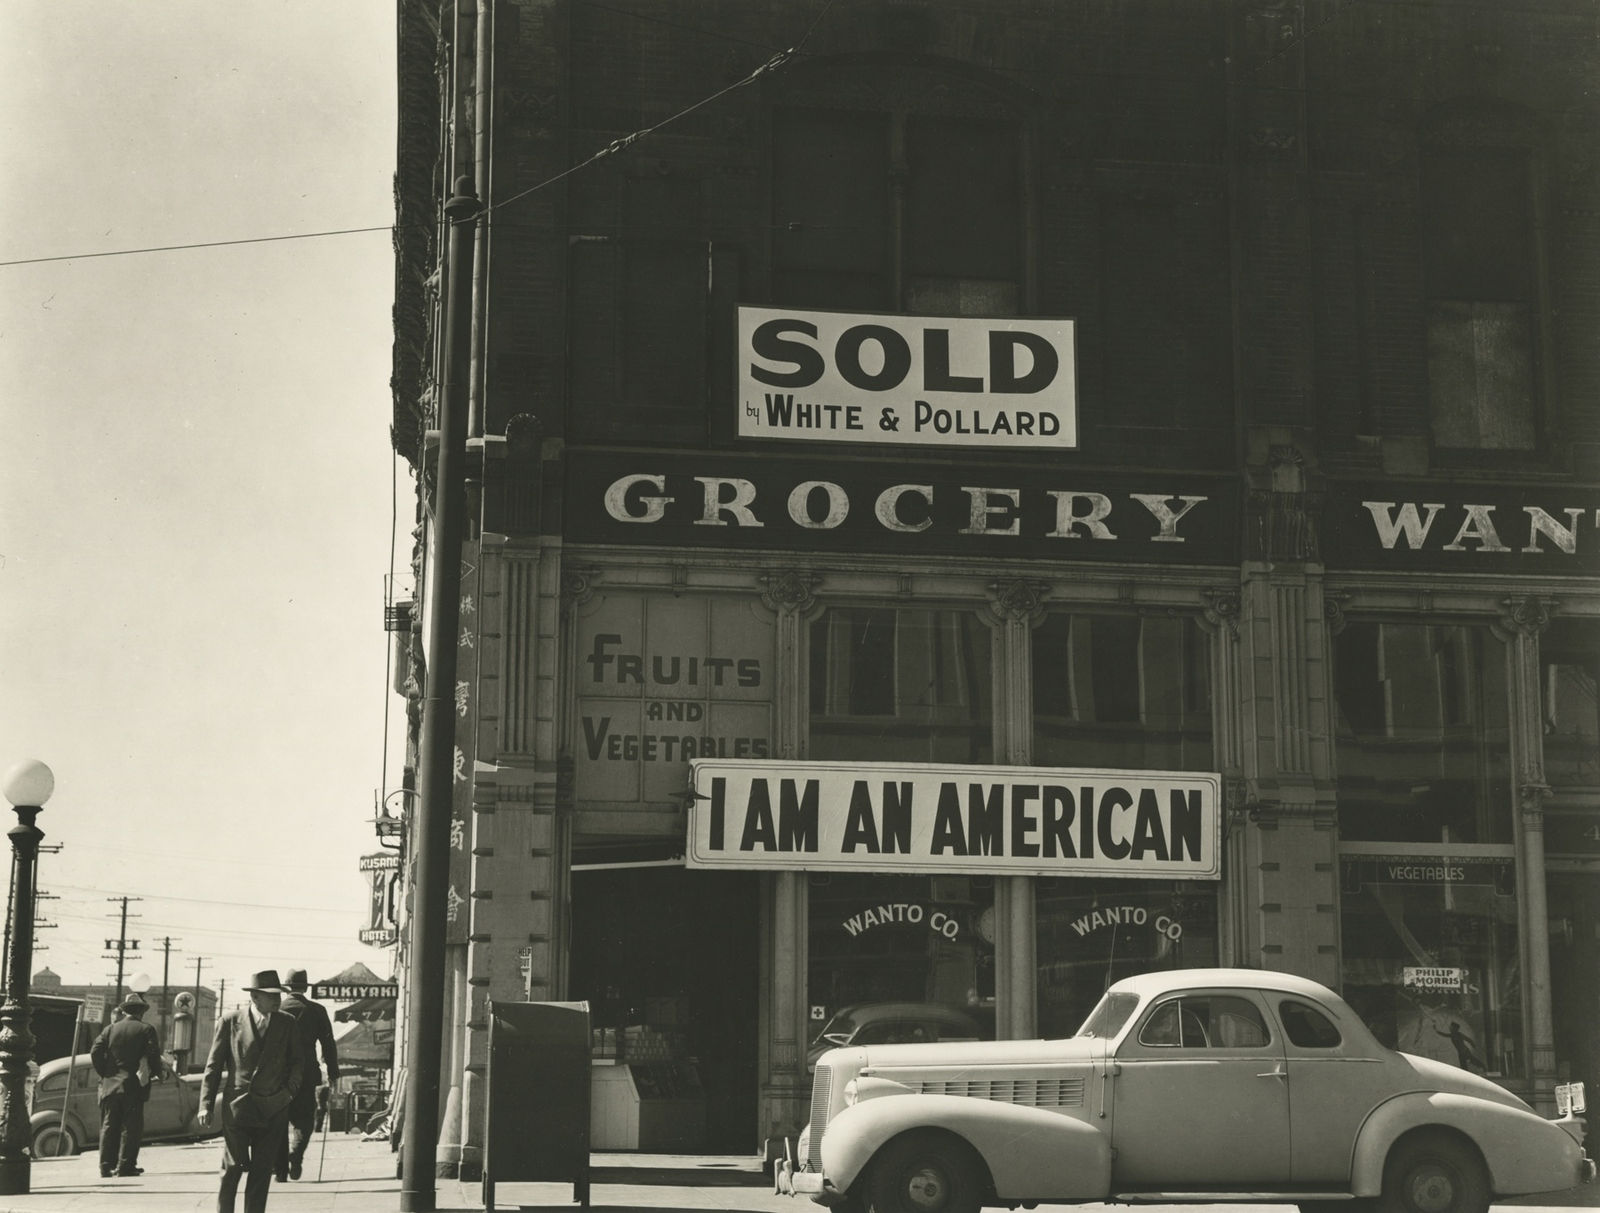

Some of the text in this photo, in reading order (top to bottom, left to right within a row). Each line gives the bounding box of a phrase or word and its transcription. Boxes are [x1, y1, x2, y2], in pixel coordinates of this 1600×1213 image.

[751, 319, 1059, 394] SOLD
[746, 393, 1060, 436] by WHITE & POLLARD
[604, 474, 1208, 542] GROCERY
[1362, 501, 1600, 554] WAN
[586, 633, 761, 687] FRUITS
[646, 702, 703, 722] AND
[709, 777, 1202, 862] I AM AN AMERICAN
[360, 857, 399, 870] KUSANO
[1388, 866, 1465, 881] VEGETABLES
[362, 930, 391, 941] HOTEL
[842, 904, 959, 942] WANTO CO.
[1070, 906, 1182, 943] WANTO CO.
[317, 986, 397, 997] SUKIYAKI
[1415, 969, 1453, 977] PHILIP
[1415, 977, 1459, 985] MORRIS
